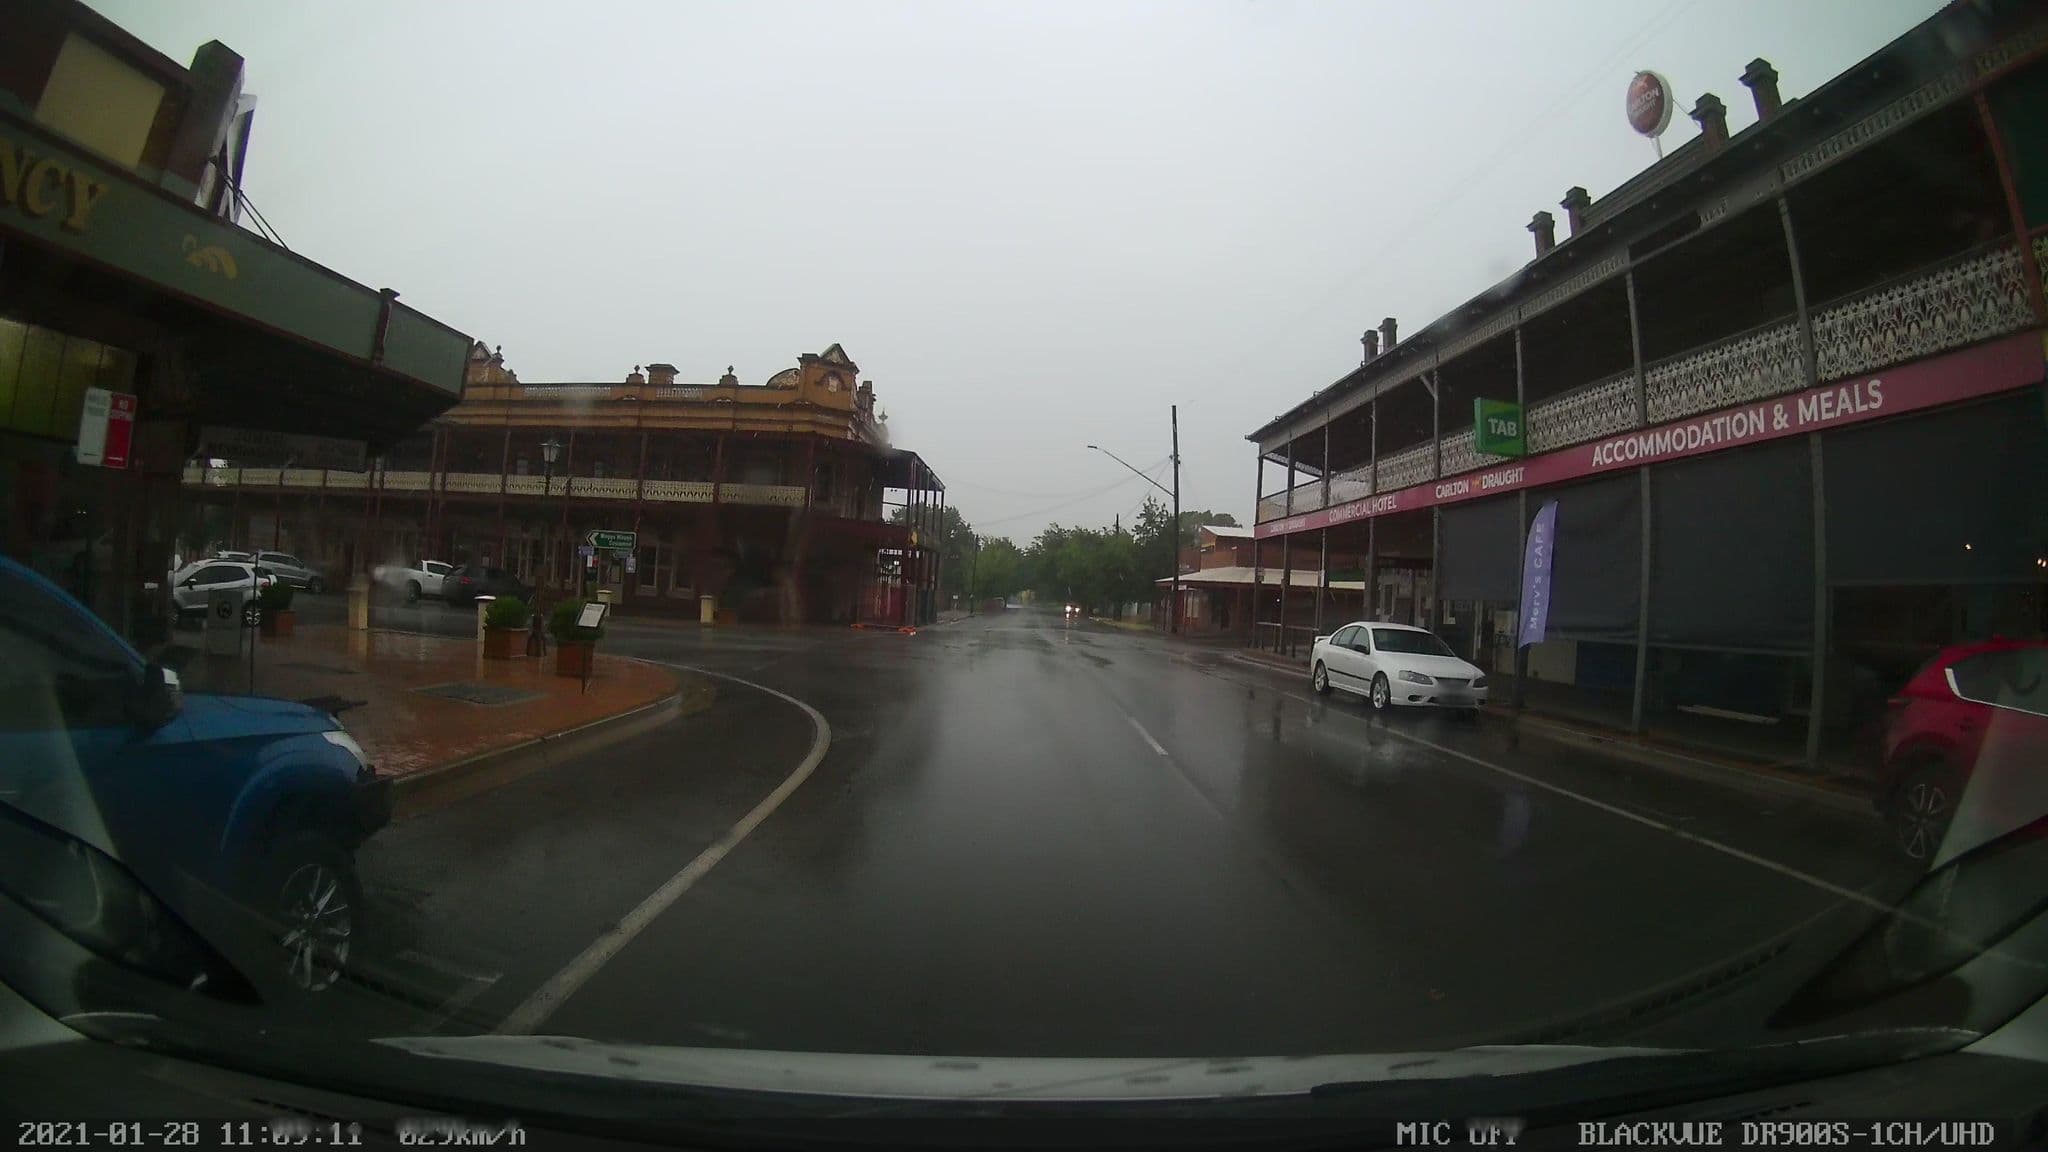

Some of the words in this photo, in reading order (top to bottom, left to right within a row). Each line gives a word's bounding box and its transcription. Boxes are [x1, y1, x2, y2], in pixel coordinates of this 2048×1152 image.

[1487, 417, 1518, 437] TAB
[1591, 408, 1766, 467] ACCOMMODATION
[1772, 403, 1790, 431] &
[1797, 378, 1884, 426] MEALS
[1435, 479, 1470, 499] CARLTON
[1481, 466, 1525, 490] DRAUGHT
[1328, 499, 1372, 524] COMMERCIAL
[1371, 494, 1398, 514] HOTEL
[1533, 523, 1545, 569] CAFE
